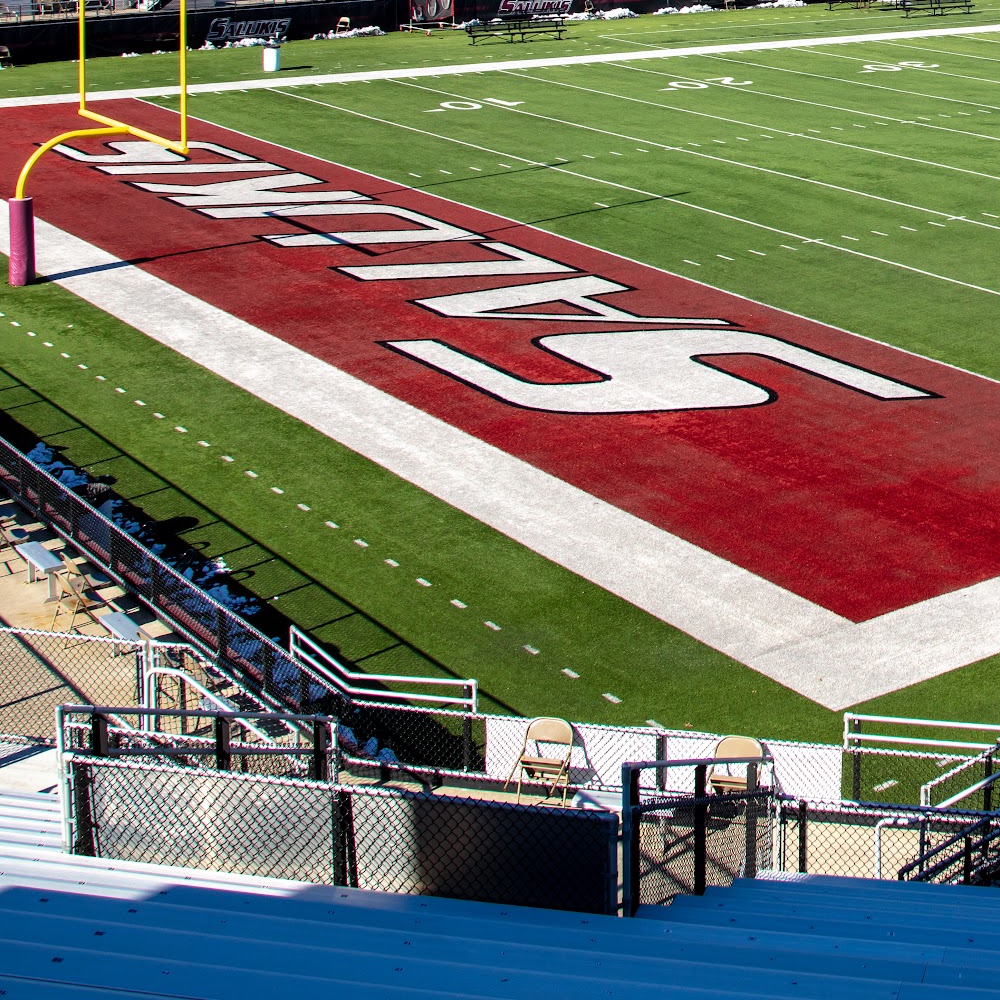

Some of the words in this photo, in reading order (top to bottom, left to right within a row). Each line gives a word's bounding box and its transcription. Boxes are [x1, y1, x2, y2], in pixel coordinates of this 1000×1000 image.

[206, 16, 292, 41] SALUKIS
[862, 61, 939, 72] 30
[668, 76, 753, 89] 20
[440, 97, 526, 110] 10
[34, 140, 944, 414] SALUKIS
